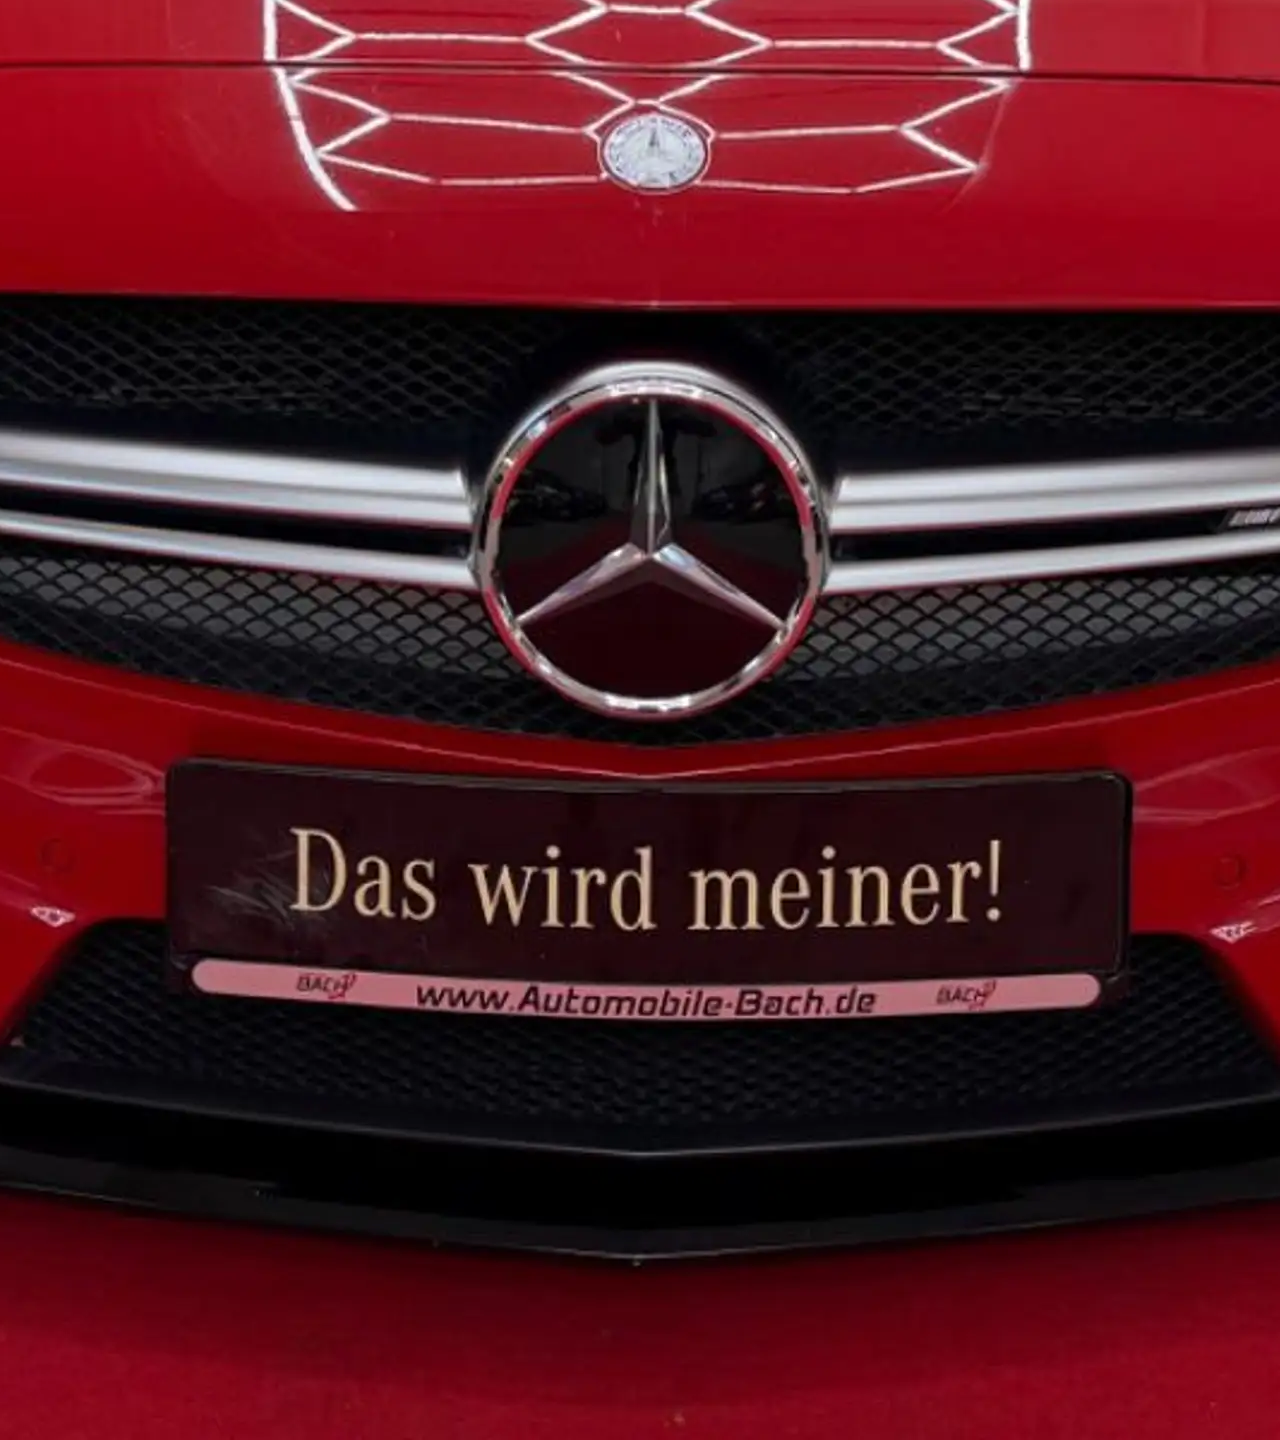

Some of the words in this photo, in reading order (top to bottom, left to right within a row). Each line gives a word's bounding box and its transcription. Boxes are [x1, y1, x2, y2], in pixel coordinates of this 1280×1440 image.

[289, 827, 437, 921] Das
[468, 845, 657, 931] wird
[687, 839, 1003, 931] meiner!
[416, 984, 878, 1017] www.Automobile-Bach.de
